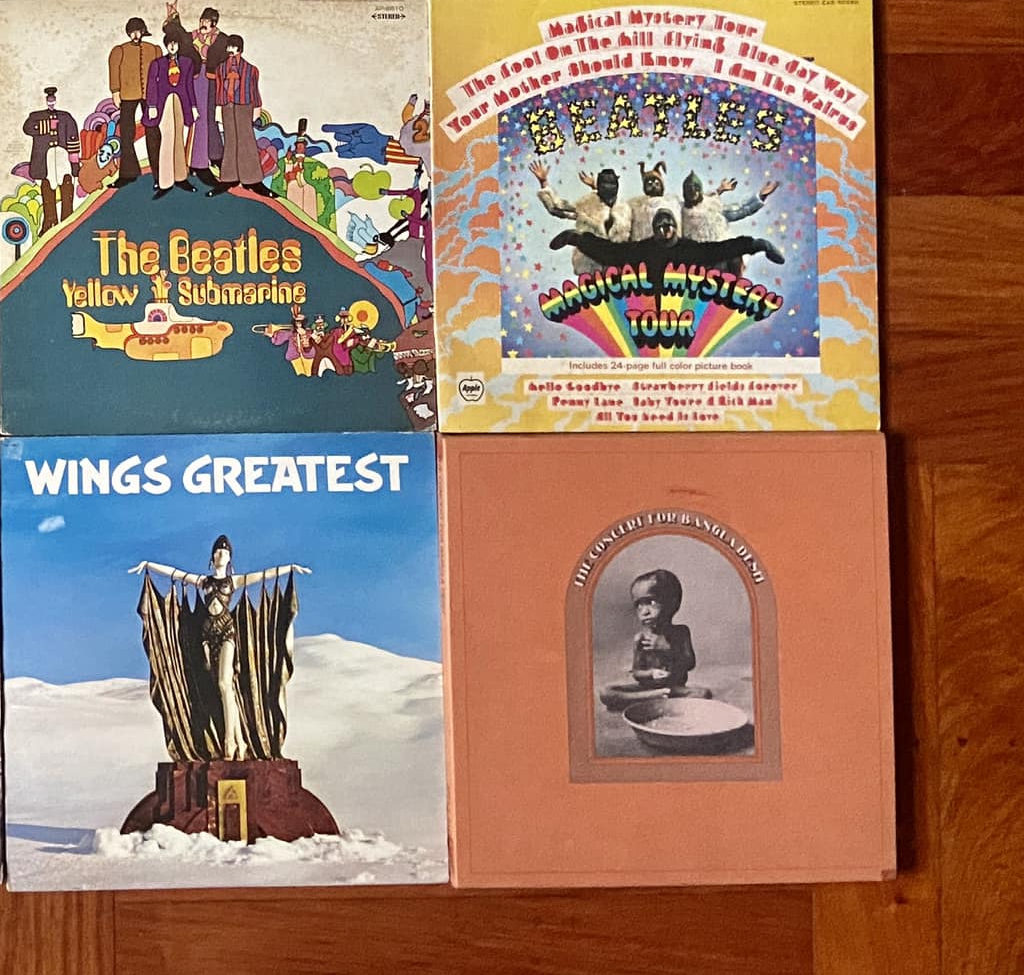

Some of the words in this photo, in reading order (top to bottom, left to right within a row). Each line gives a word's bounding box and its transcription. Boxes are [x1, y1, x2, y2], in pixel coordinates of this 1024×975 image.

[548, 11, 621, 38] Magical
[629, 9, 706, 27] Mystery
[713, 14, 758, 37] Tour
[447, 101, 489, 133] Your
[493, 70, 561, 107] Mother
[568, 53, 633, 76] Should
[640, 52, 694, 68] Know
[714, 59, 723, 74] I
[762, 70, 796, 96] The
[802, 87, 859, 131] Walrus
[460, 73, 496, 98] The
[545, 43, 573, 60] On
[574, 36, 612, 53] The
[738, 42, 780, 66] Blue
[824, 75, 856, 104] Way
[525, 92, 787, 155] BEATLES
[91, 228, 160, 276] The
[169, 227, 302, 275] Beatles
[62, 278, 139, 308] Yellow
[178, 275, 306, 305] Submarine
[538, 261, 655, 322] MAGICAL
[663, 261, 784, 321] MYSTERY
[625, 309, 697, 348] TOUR
[462, 384, 481, 393] Apple
[569, 361, 608, 370] Includes
[652, 361, 667, 370] full
[669, 361, 692, 370] color
[695, 361, 727, 372] picture
[731, 361, 753, 370] book
[24, 455, 172, 496] WINGS
[182, 452, 409, 496] GREATEST
[573, 559, 593, 588] THE
[589, 515, 645, 560] CONCERT
[647, 511, 676, 525] FOR
[734, 543, 766, 585] DESH
